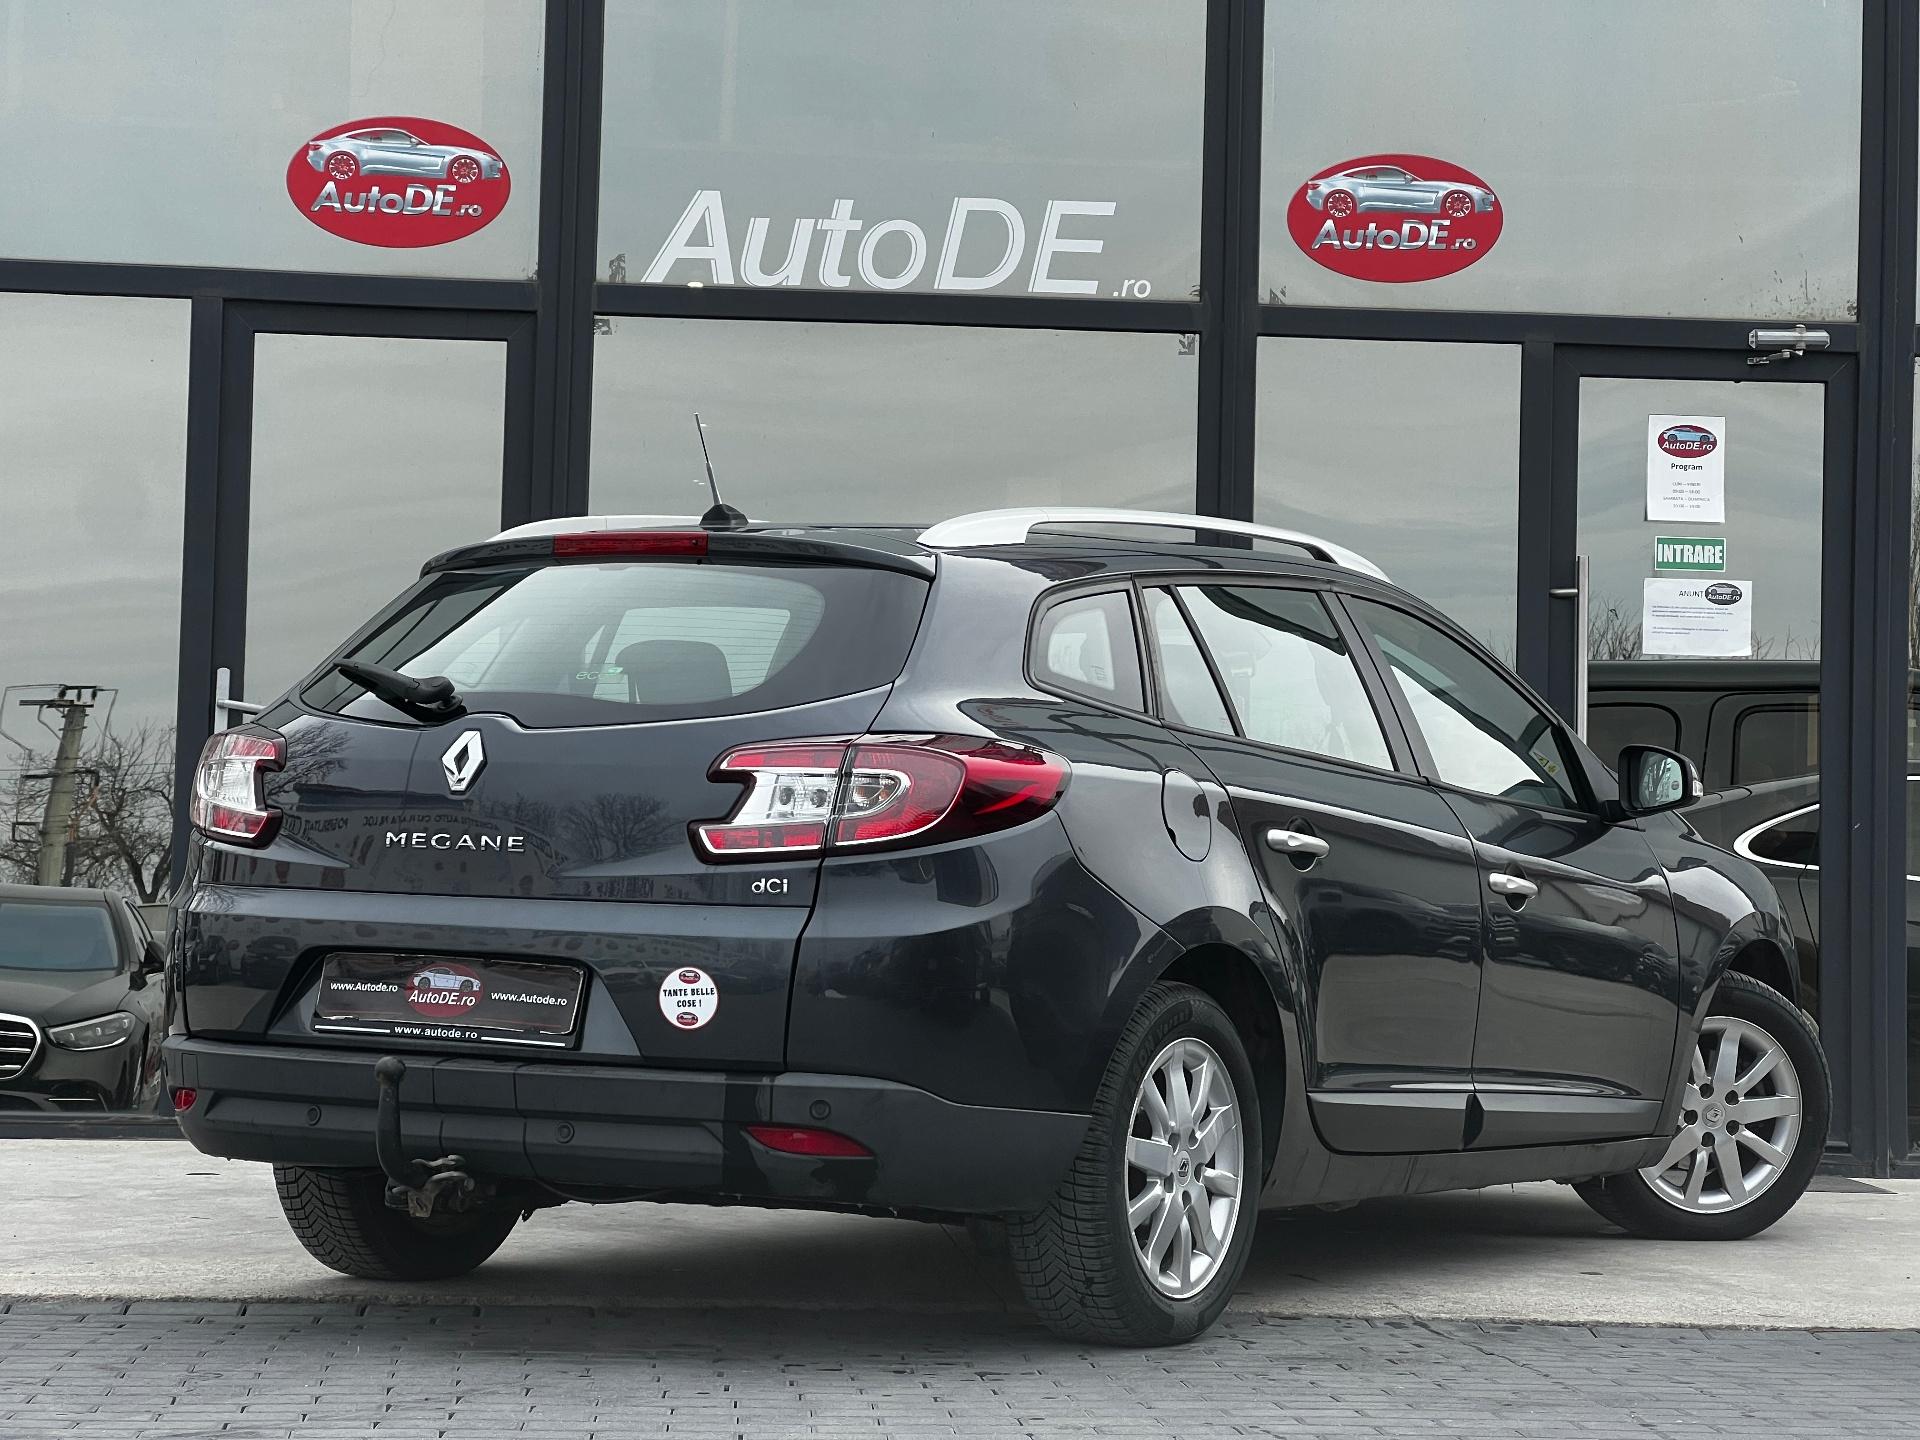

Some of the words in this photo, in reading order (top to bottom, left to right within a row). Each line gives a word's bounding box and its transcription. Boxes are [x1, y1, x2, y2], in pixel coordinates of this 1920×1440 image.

[1662, 441, 1713, 450] AutoDE.ro
[1670, 462, 1703, 472] Program
[1657, 543, 1723, 564] INTRARE
[385, 831, 525, 853] MEGANE
[751, 877, 788, 895] dCi
[330, 982, 398, 993] www.Autode.ro
[662, 988, 689, 997] TANTE
[690, 987, 716, 996] BELLE
[408, 989, 476, 1007] AutoDE.ro
[491, 991, 567, 1006] www.Autode.ro
[676, 999, 697, 1008] COSE
[394, 1025, 478, 1039] www.autode.ro
